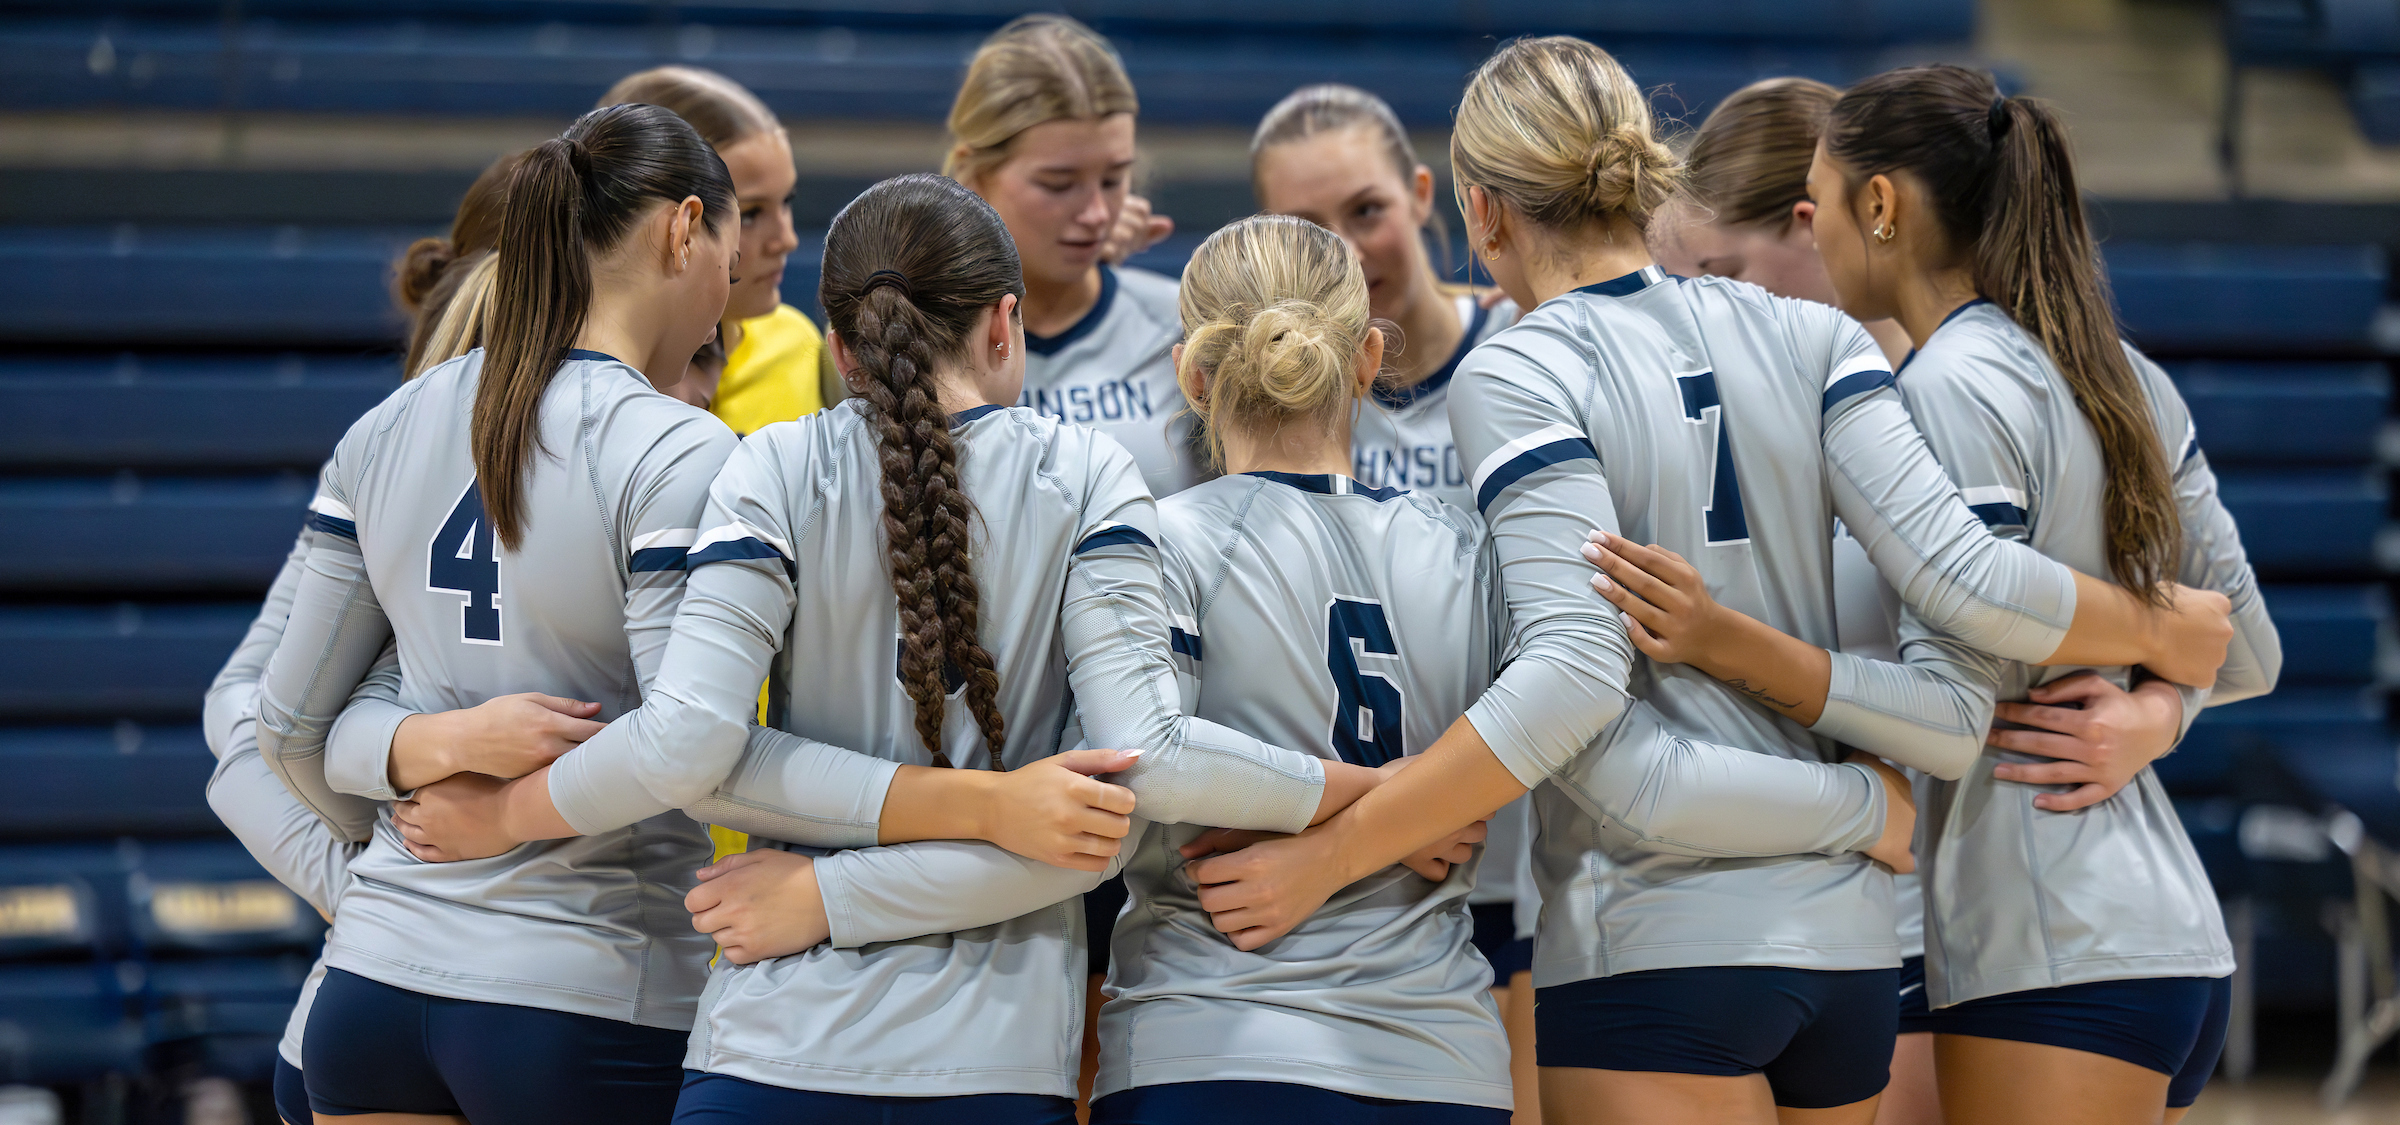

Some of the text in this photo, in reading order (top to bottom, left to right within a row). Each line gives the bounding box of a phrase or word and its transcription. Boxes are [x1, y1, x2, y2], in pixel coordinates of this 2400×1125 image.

[1671, 366, 1751, 547] 7
[426, 468, 503, 647] 4
[1324, 592, 1408, 769] 6
